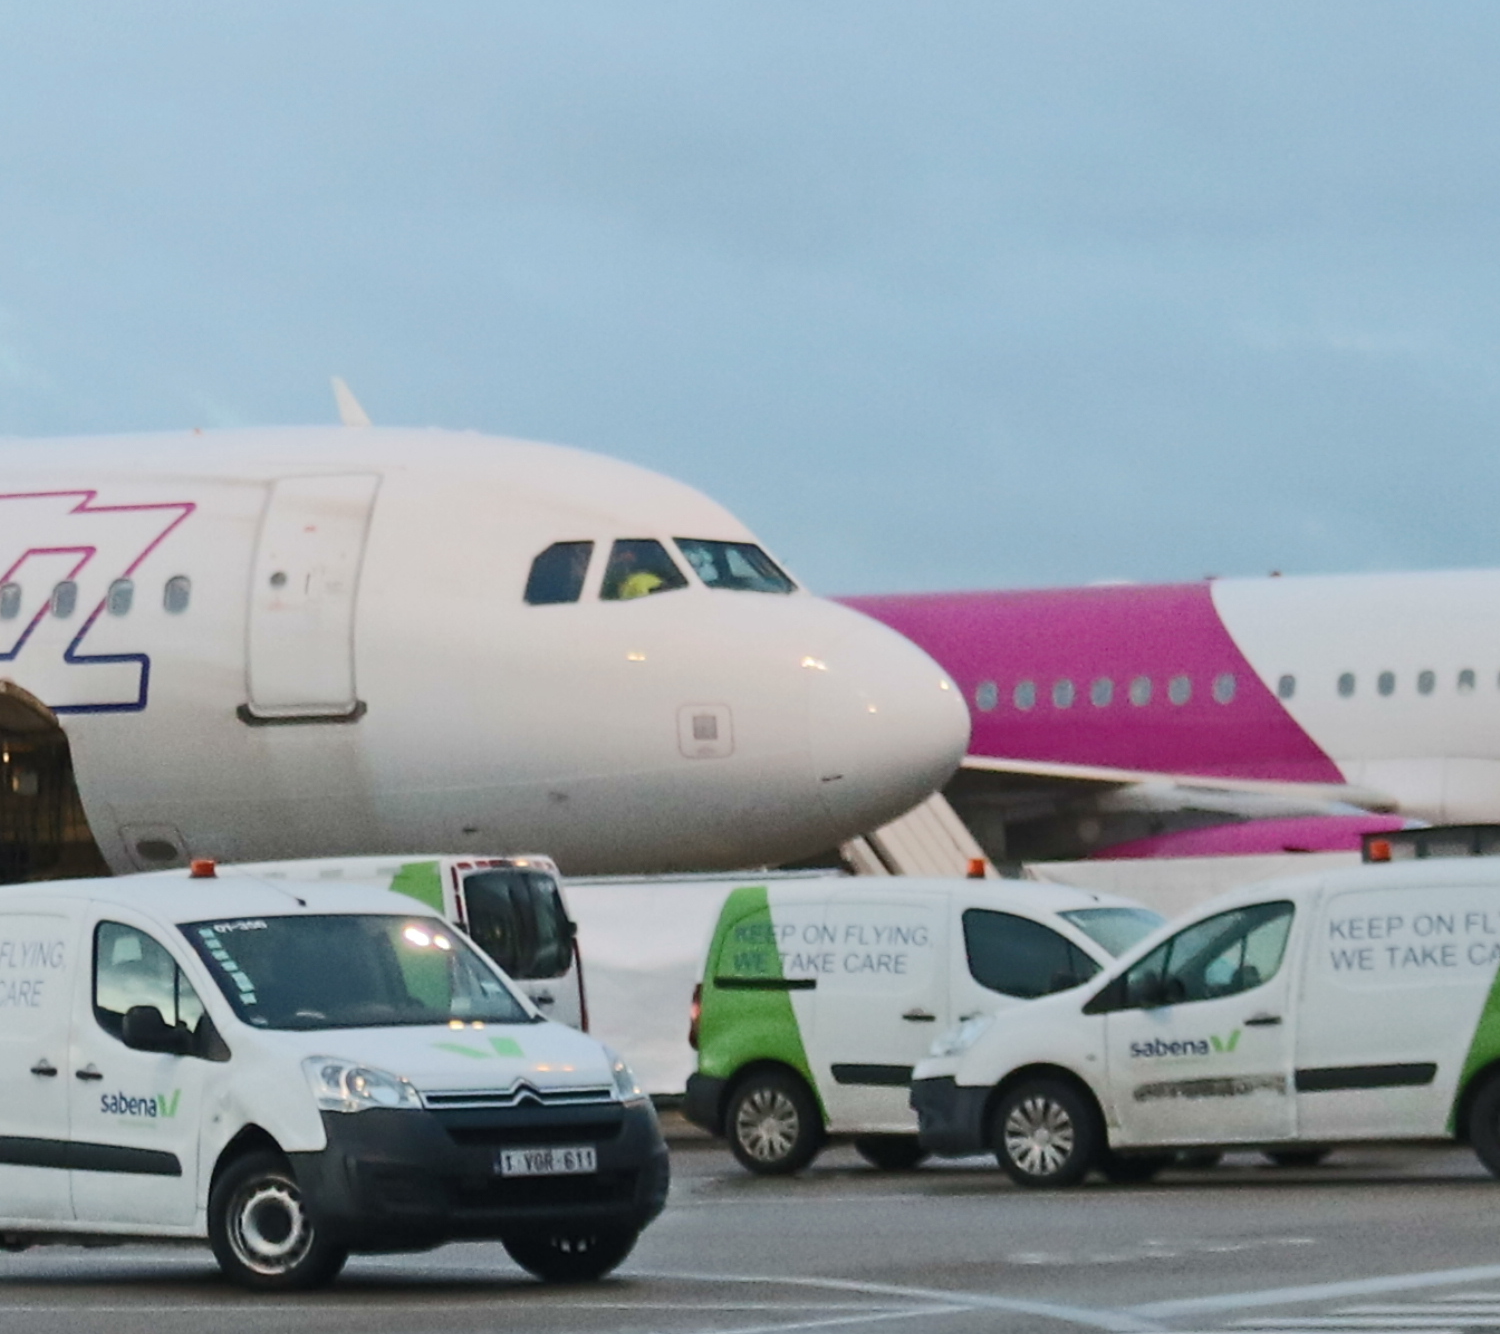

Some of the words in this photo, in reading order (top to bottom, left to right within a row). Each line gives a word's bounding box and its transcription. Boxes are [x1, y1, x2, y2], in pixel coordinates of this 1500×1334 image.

[802, 924, 836, 944] ON
[1329, 917, 1402, 940] KEEP
[1413, 915, 1454, 937] ON
[843, 953, 908, 974] CARE
[1331, 948, 1374, 971] WE
[1386, 944, 1458, 968] TAKE
[1130, 1037, 1210, 1058] sabena
[101, 1091, 157, 1118] sabena
